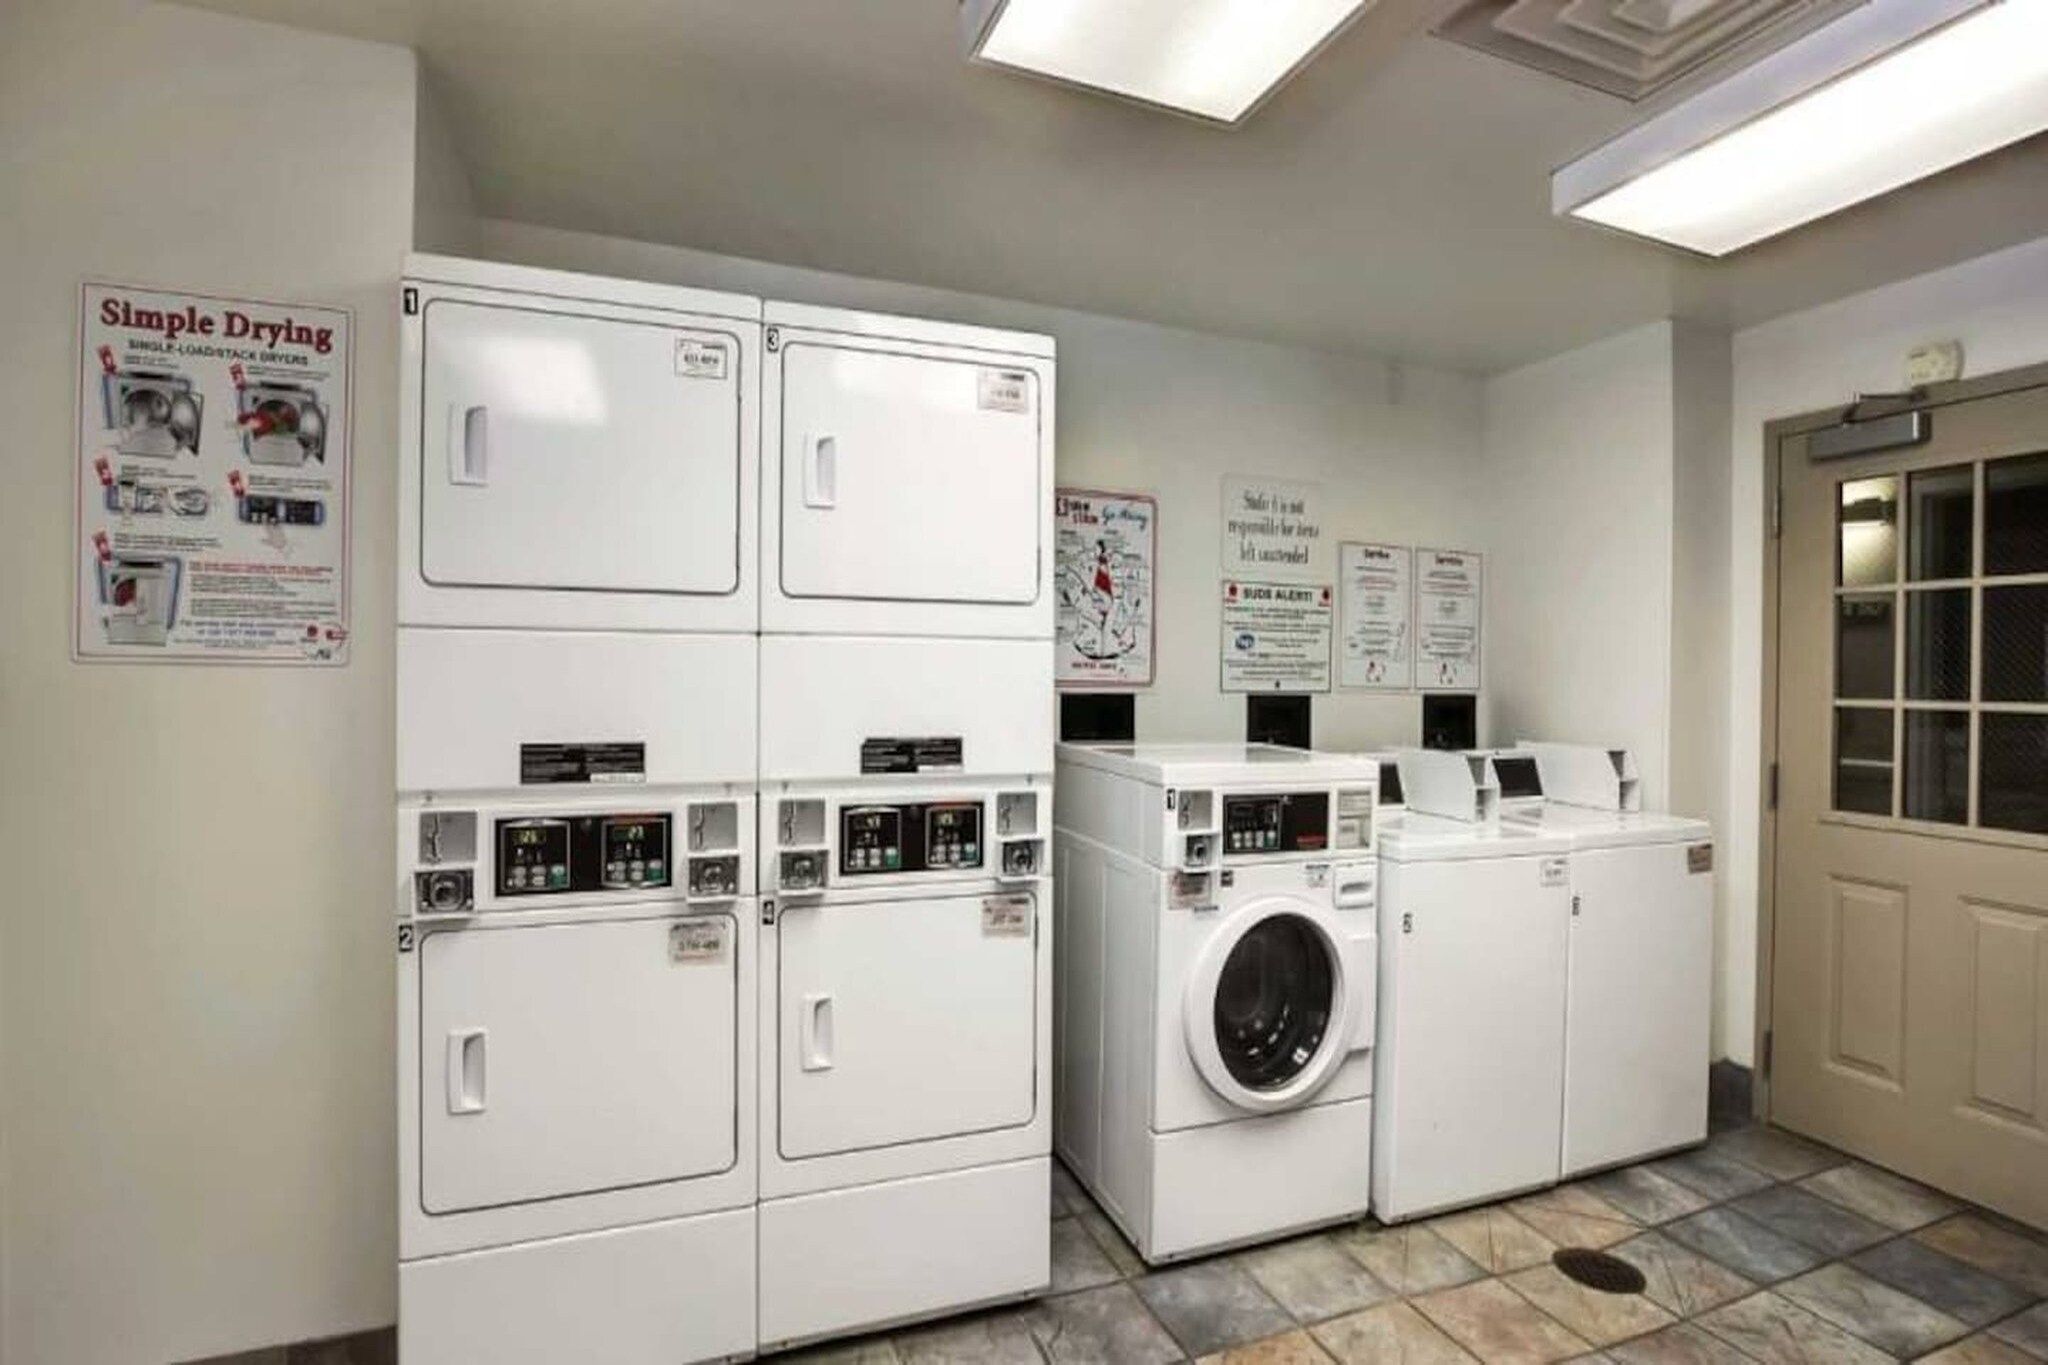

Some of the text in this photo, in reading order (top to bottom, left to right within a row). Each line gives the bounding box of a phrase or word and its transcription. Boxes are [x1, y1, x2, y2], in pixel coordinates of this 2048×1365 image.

[101, 298, 333, 354] Simple Drying
[1243, 587, 1272, 600] SUDS
